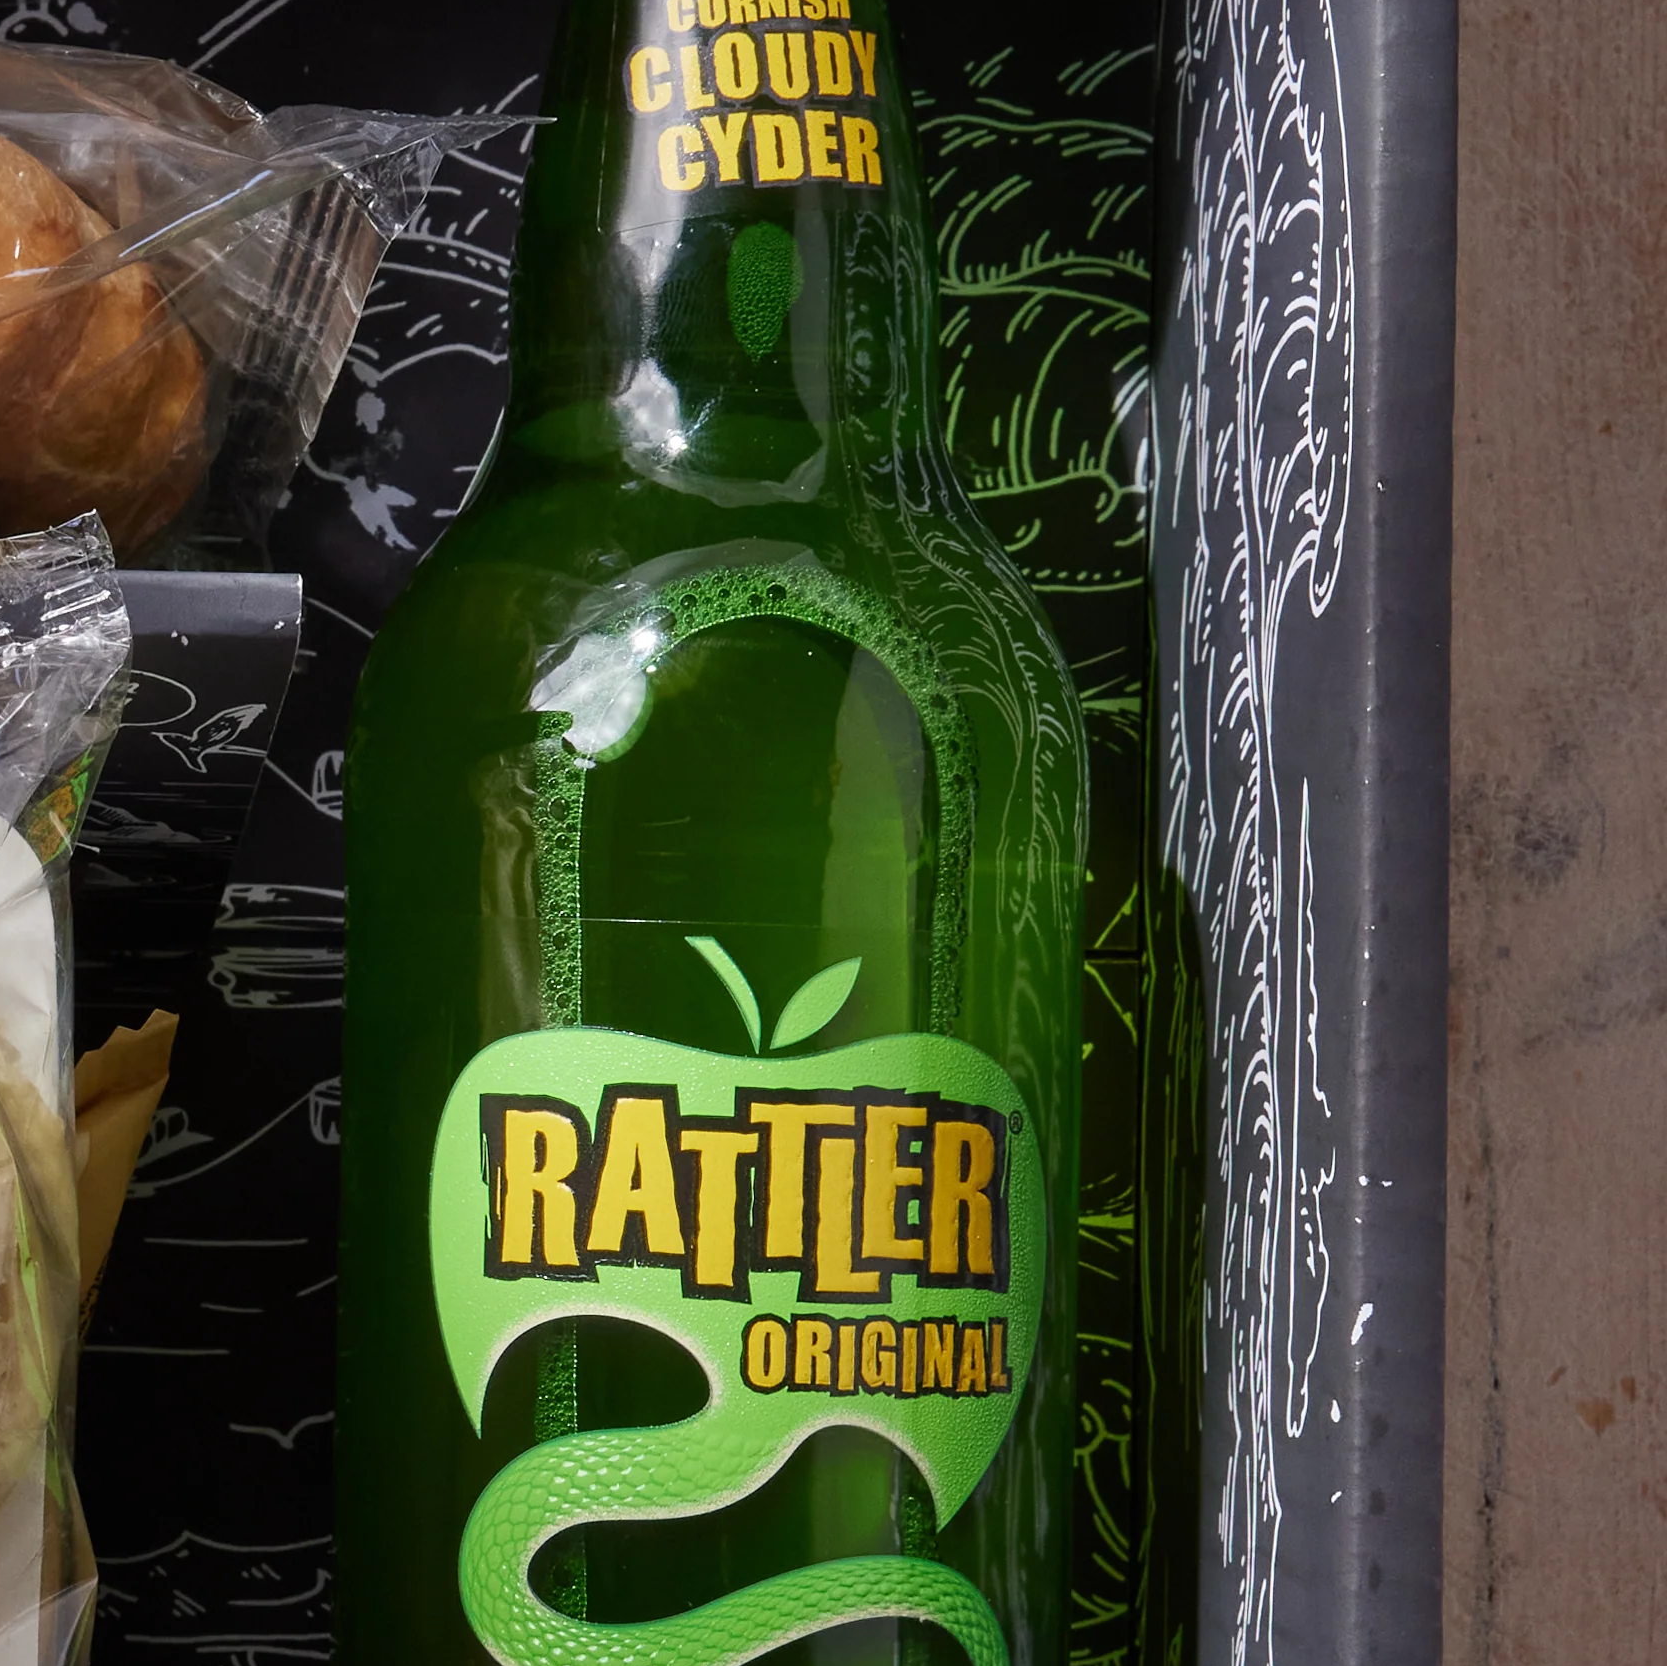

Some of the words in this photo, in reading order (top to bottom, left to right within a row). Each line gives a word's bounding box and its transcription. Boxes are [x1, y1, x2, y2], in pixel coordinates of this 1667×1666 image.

[630, 30, 877, 114] CLOUDY
[657, 111, 883, 191] CYDER
[497, 1093, 999, 1298] RATTLER
[745, 1321, 1009, 1395] ORIGINAL
